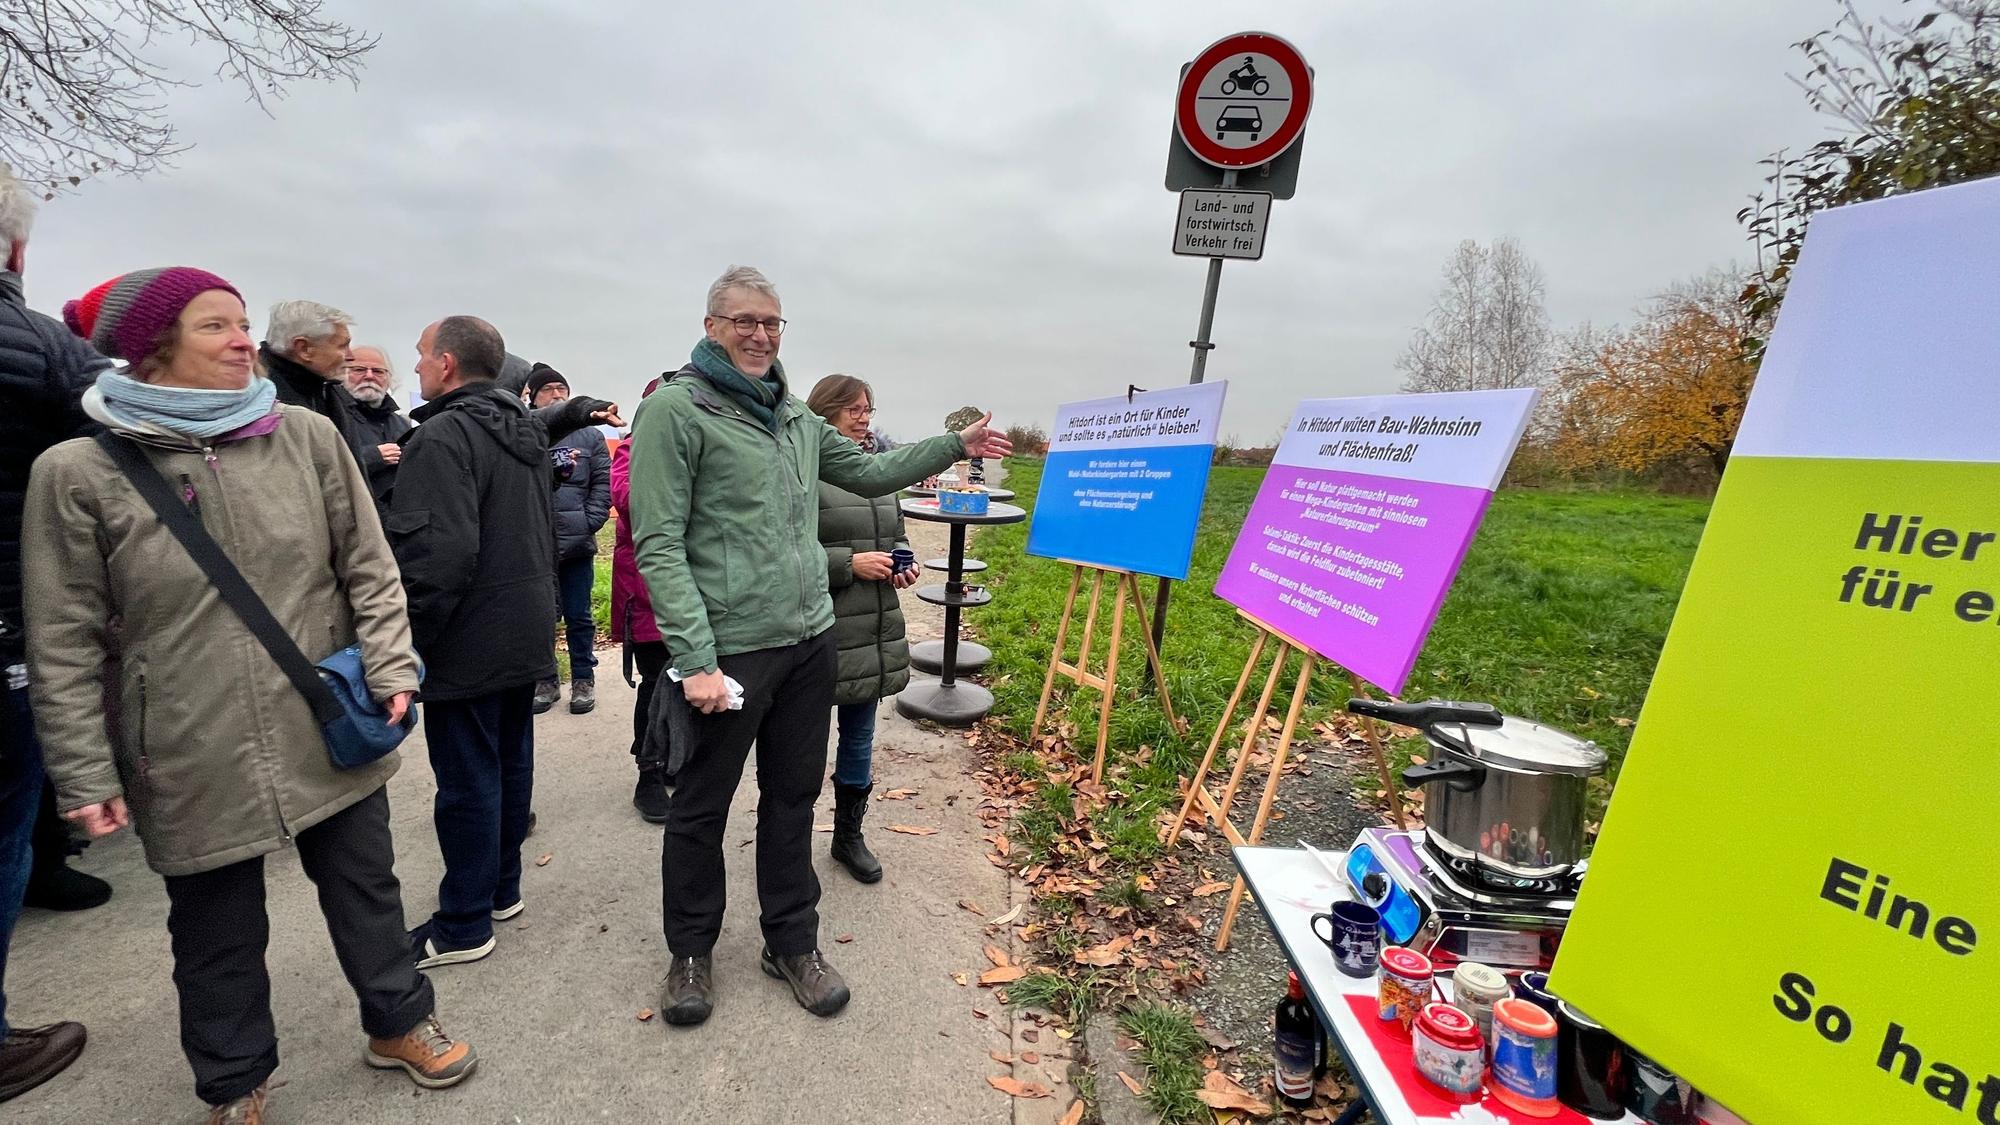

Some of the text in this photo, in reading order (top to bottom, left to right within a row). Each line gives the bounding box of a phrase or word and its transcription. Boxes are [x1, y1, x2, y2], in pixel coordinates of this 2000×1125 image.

[1194, 199, 1255, 214] Land- und
[1186, 216, 1257, 233] forstwirtsch.
[1185, 234, 1254, 250] Verkehr frei
[1068, 405, 1190, 429] Hitdorf ist ein Ort für Kinder
[1297, 415, 1482, 437] In Hitdorf wüten Bau-Wahnsinn
[1058, 430, 1073, 442] und
[1073, 429, 1095, 441] sollte
[1096, 430, 1107, 440] es
[1158, 419, 1201, 436] bleiben!
[1318, 440, 1419, 463] und Flächenfraß!
[1145, 469, 1172, 480] Gruppen
[1294, 477, 1419, 508] Hier soll Natur plattgemacht werden
[1367, 505, 1383, 519] mit
[1382, 508, 1428, 528] sinnlosem
[1854, 512, 1996, 562] Hier
[1299, 535, 1323, 551] Zuerst
[1320, 542, 1334, 555] die
[1332, 545, 1404, 581] Kindertagesstätte,
[1310, 554, 1338, 574] Feldflur
[1336, 565, 1386, 590] zubetoniert!
[1278, 592, 1322, 618] und erhalten!
[1298, 582, 1342, 610] Naturflächen
[1340, 602, 1379, 627] schützen
[1840, 567, 2000, 626] für e
[1819, 857, 1977, 956] Eine
[1773, 972, 1852, 1043] So
